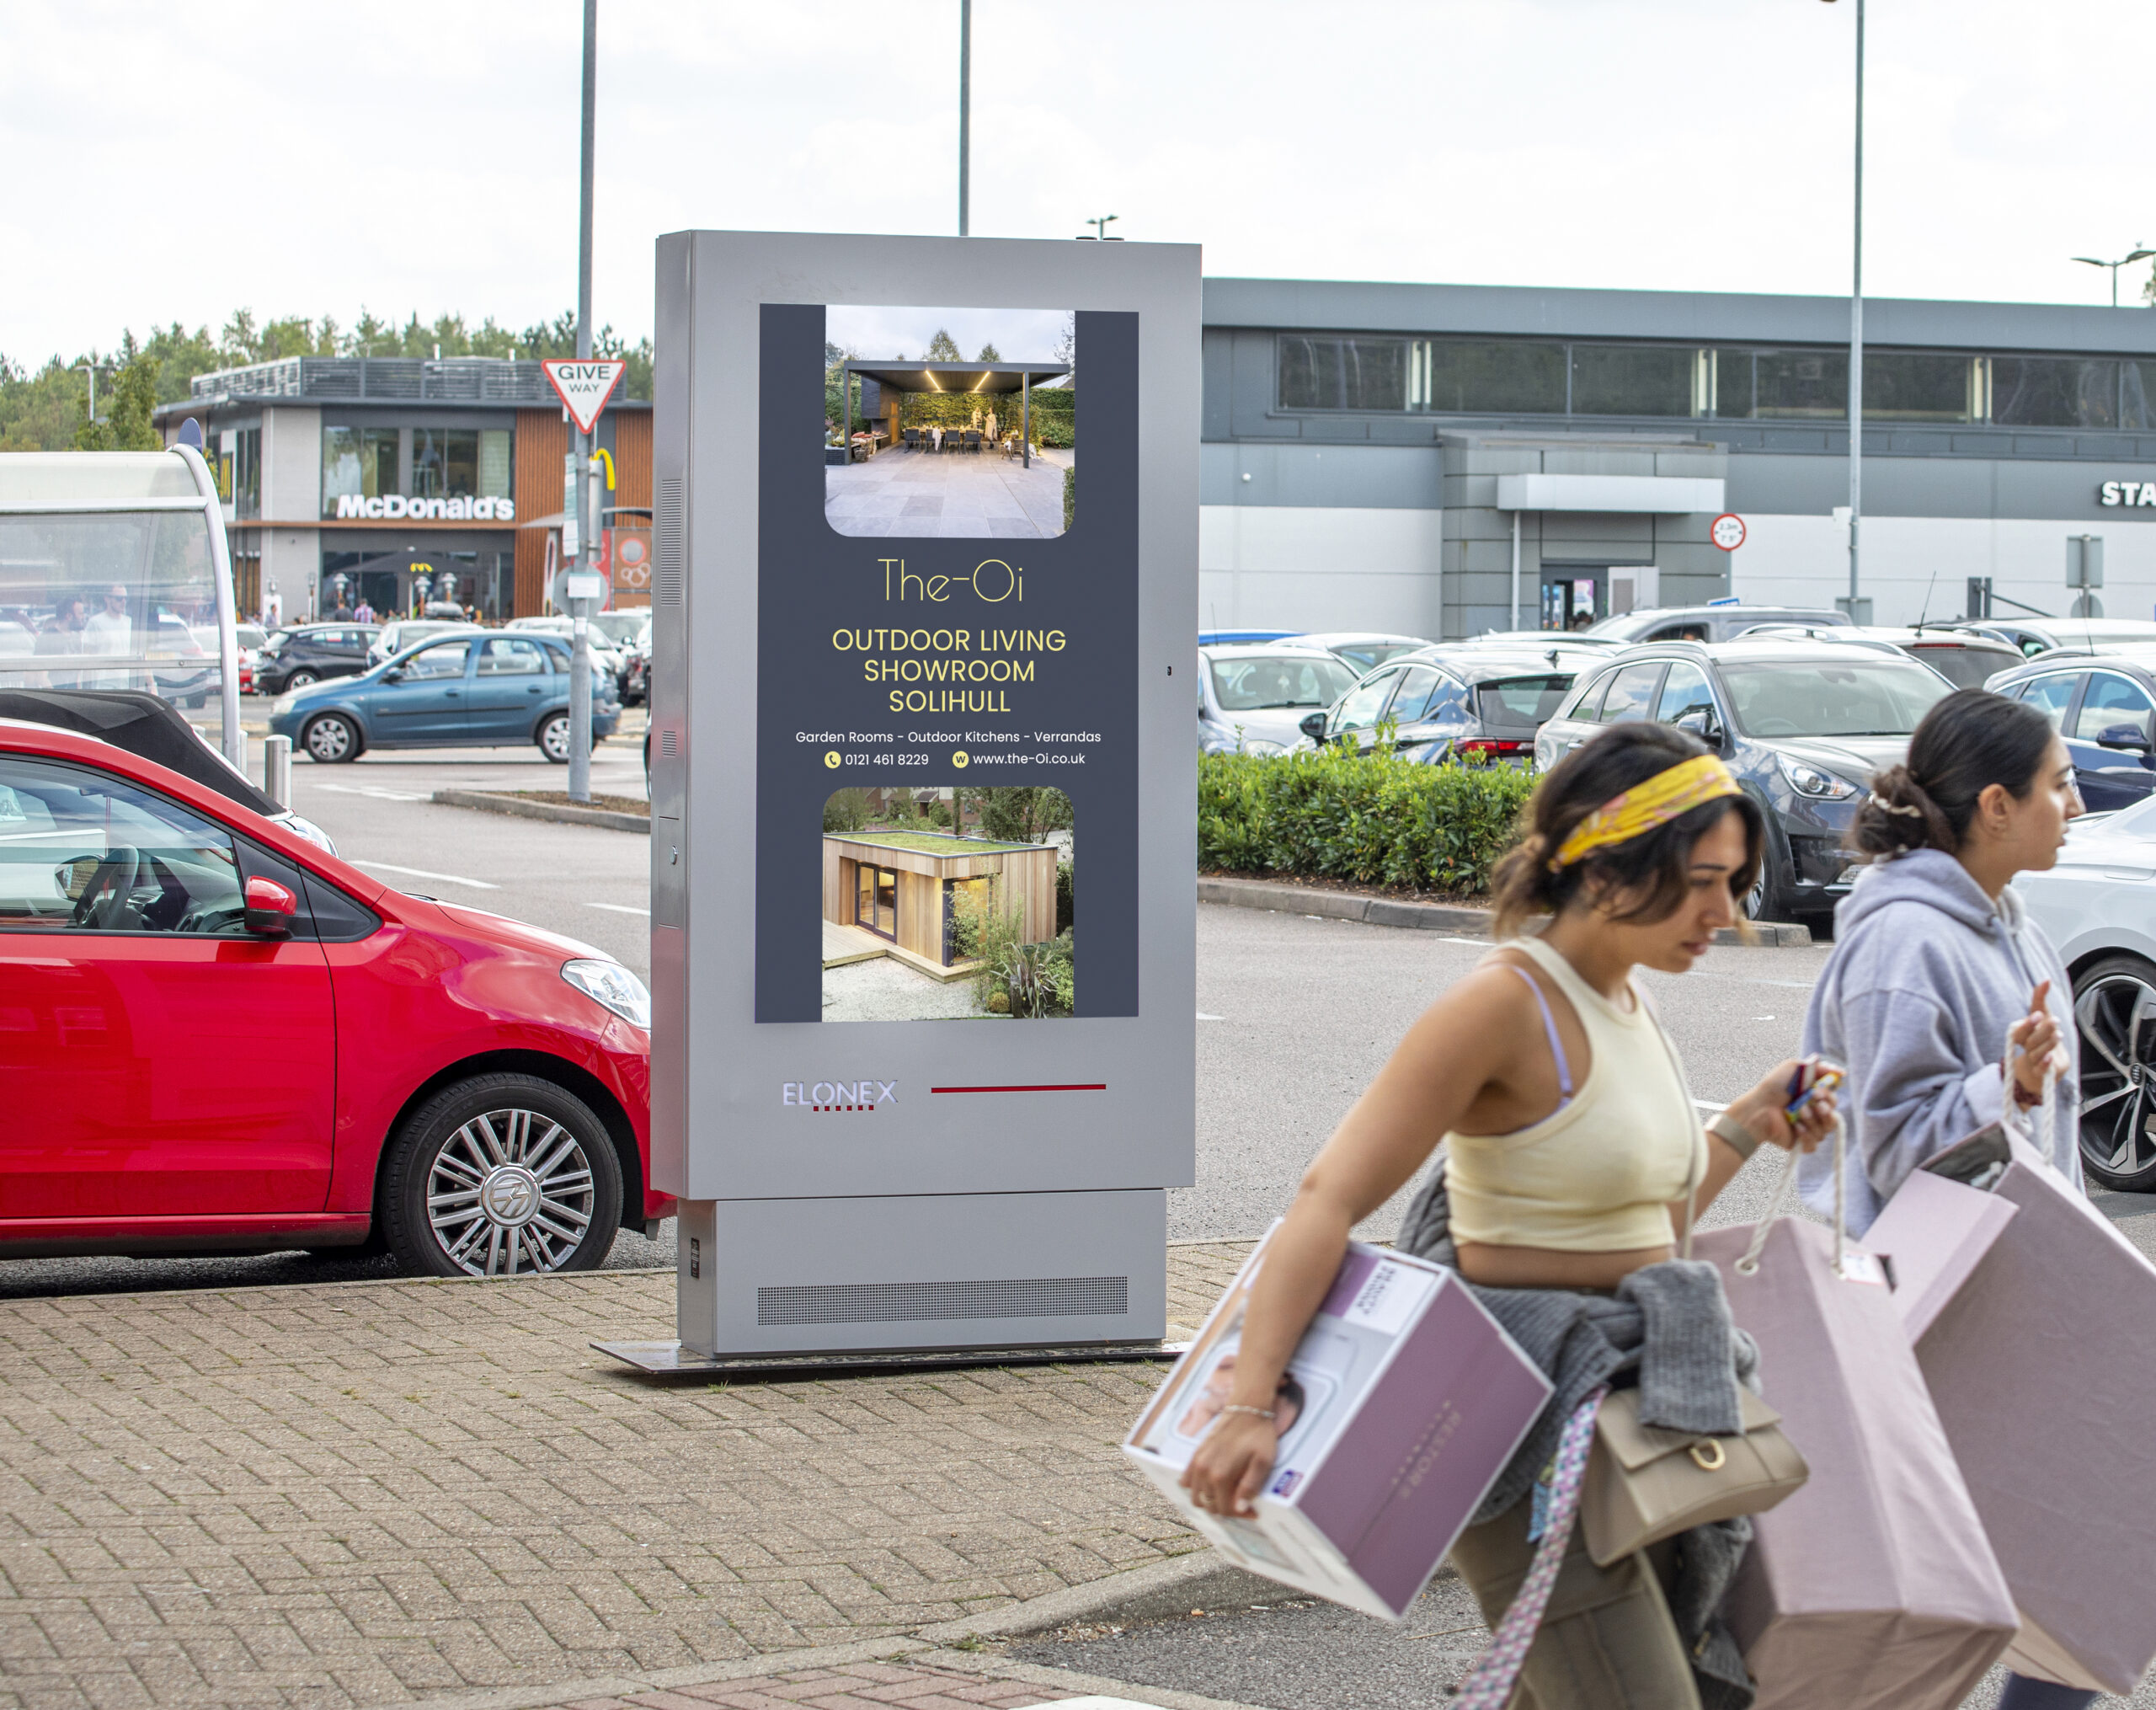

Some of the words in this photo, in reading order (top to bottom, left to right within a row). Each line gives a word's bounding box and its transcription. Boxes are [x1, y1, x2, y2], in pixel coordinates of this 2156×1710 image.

[558, 366, 611, 380] GIVE
[568, 383, 600, 393] WAY
[2101, 481, 2156, 506] STA
[337, 494, 515, 521] McDonald's
[878, 558, 1023, 602] The-Oi
[832, 628, 970, 651] OUTDOOR
[980, 629, 1066, 652] LIVING
[864, 660, 1035, 682] SHOWROOM
[889, 690, 1011, 713] SOLIHULL
[796, 731, 846, 743] Garden
[849, 731, 894, 743] Rooms
[908, 730, 962, 743] Outdoor
[965, 730, 1020, 743] Kitchens
[1034, 730, 1102, 743] Verrandas
[845, 754, 870, 765] 0121
[873, 754, 894, 765] 461
[898, 754, 929, 765] 8229
[973, 752, 1086, 764] www.the-Oi.co.uk
[782, 1080, 899, 1105] ELONEX
